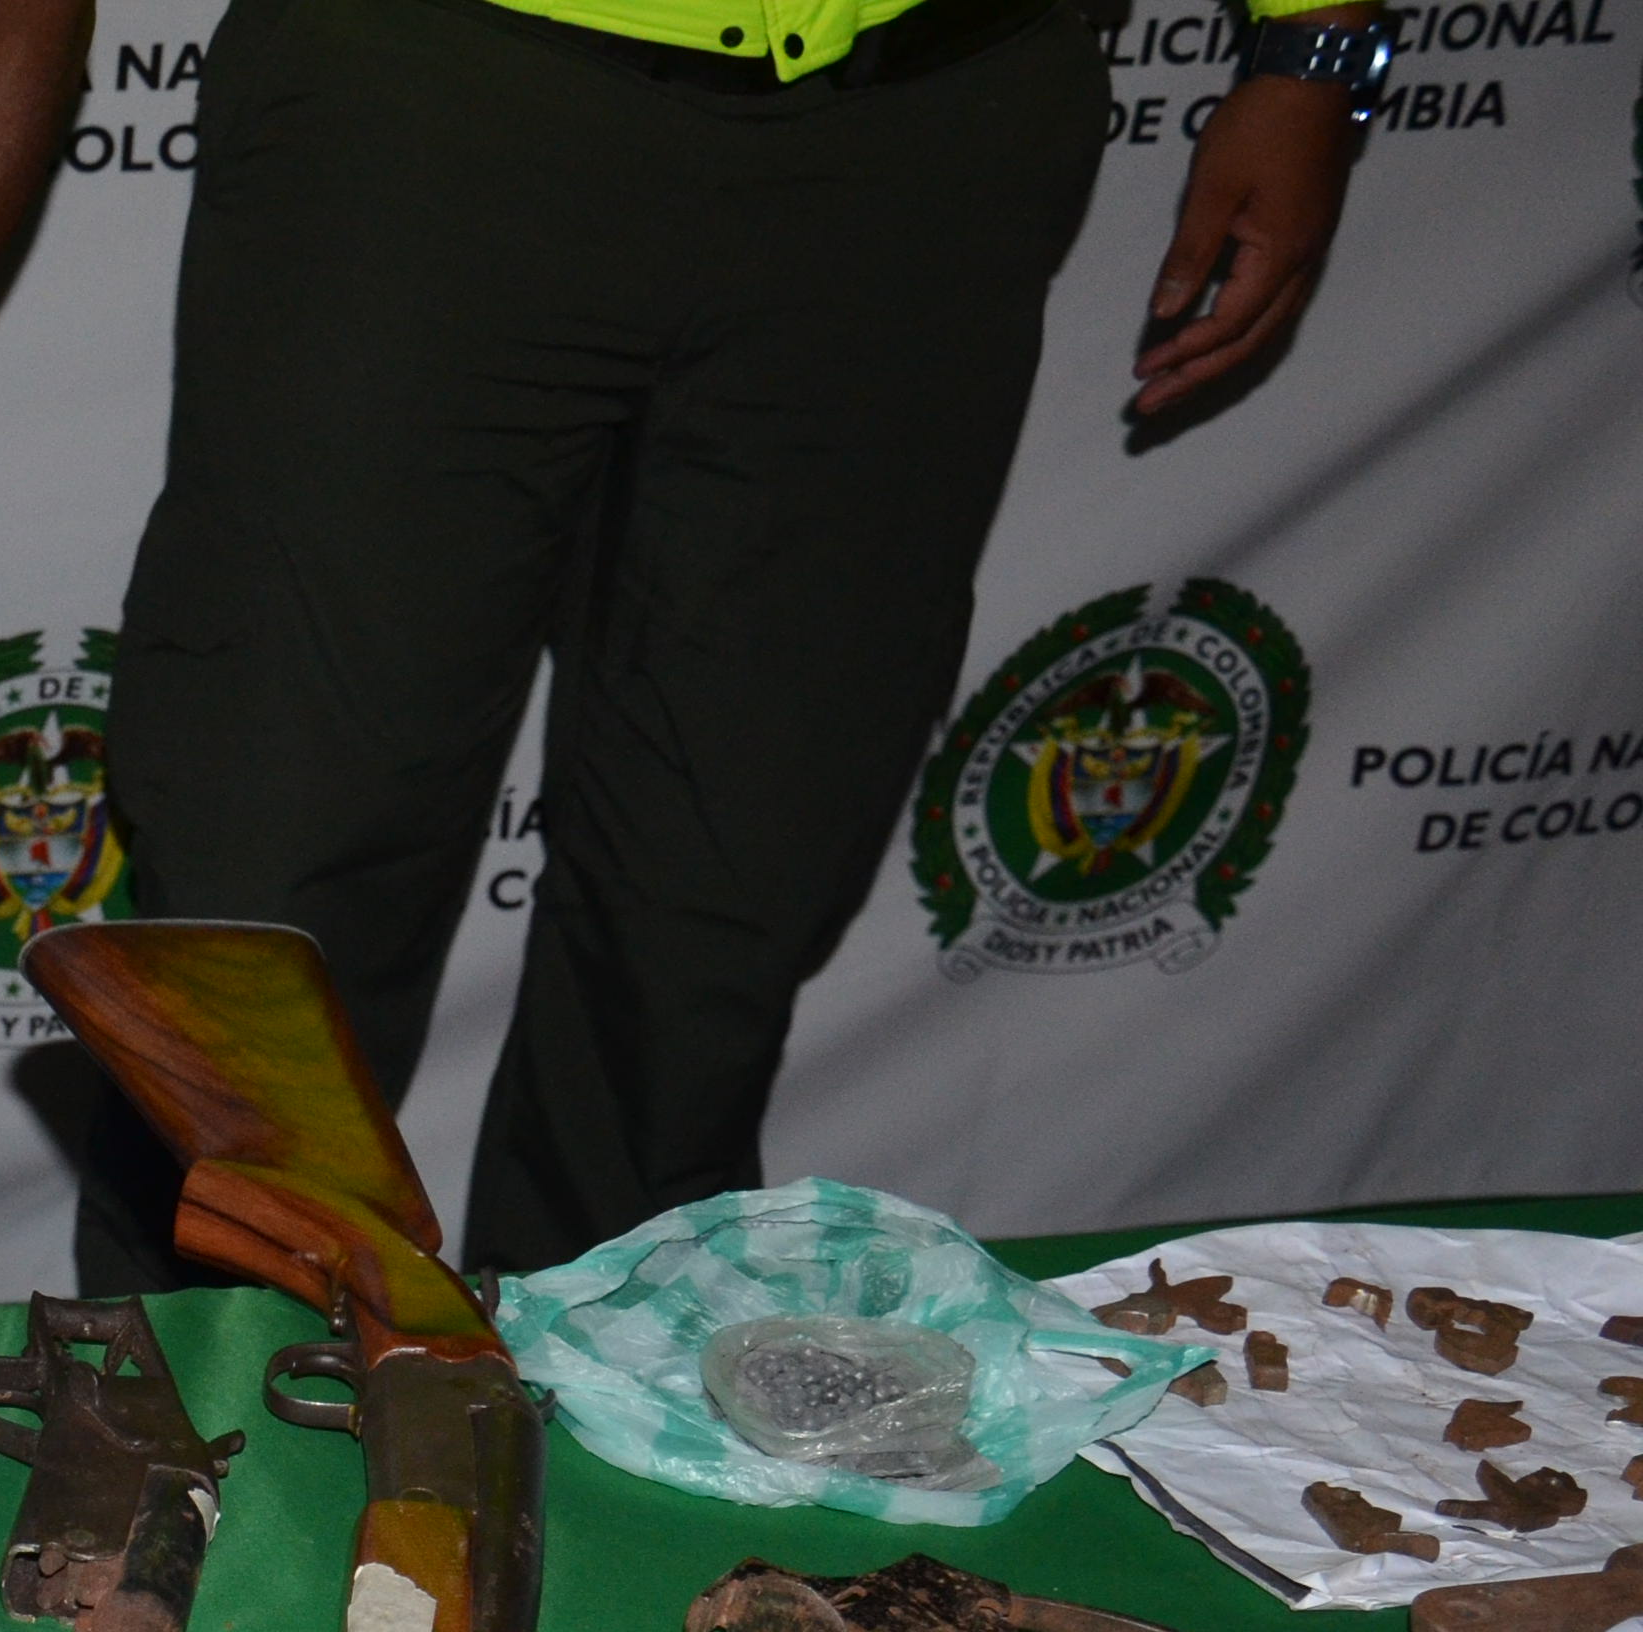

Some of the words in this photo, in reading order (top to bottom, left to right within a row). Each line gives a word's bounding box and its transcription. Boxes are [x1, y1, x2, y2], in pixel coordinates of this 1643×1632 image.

[38, 676, 84, 700] DE
[1351, 730, 1573, 788] POLICÍA
[1416, 810, 1490, 853] DE
[1502, 792, 1643, 843] COLO
